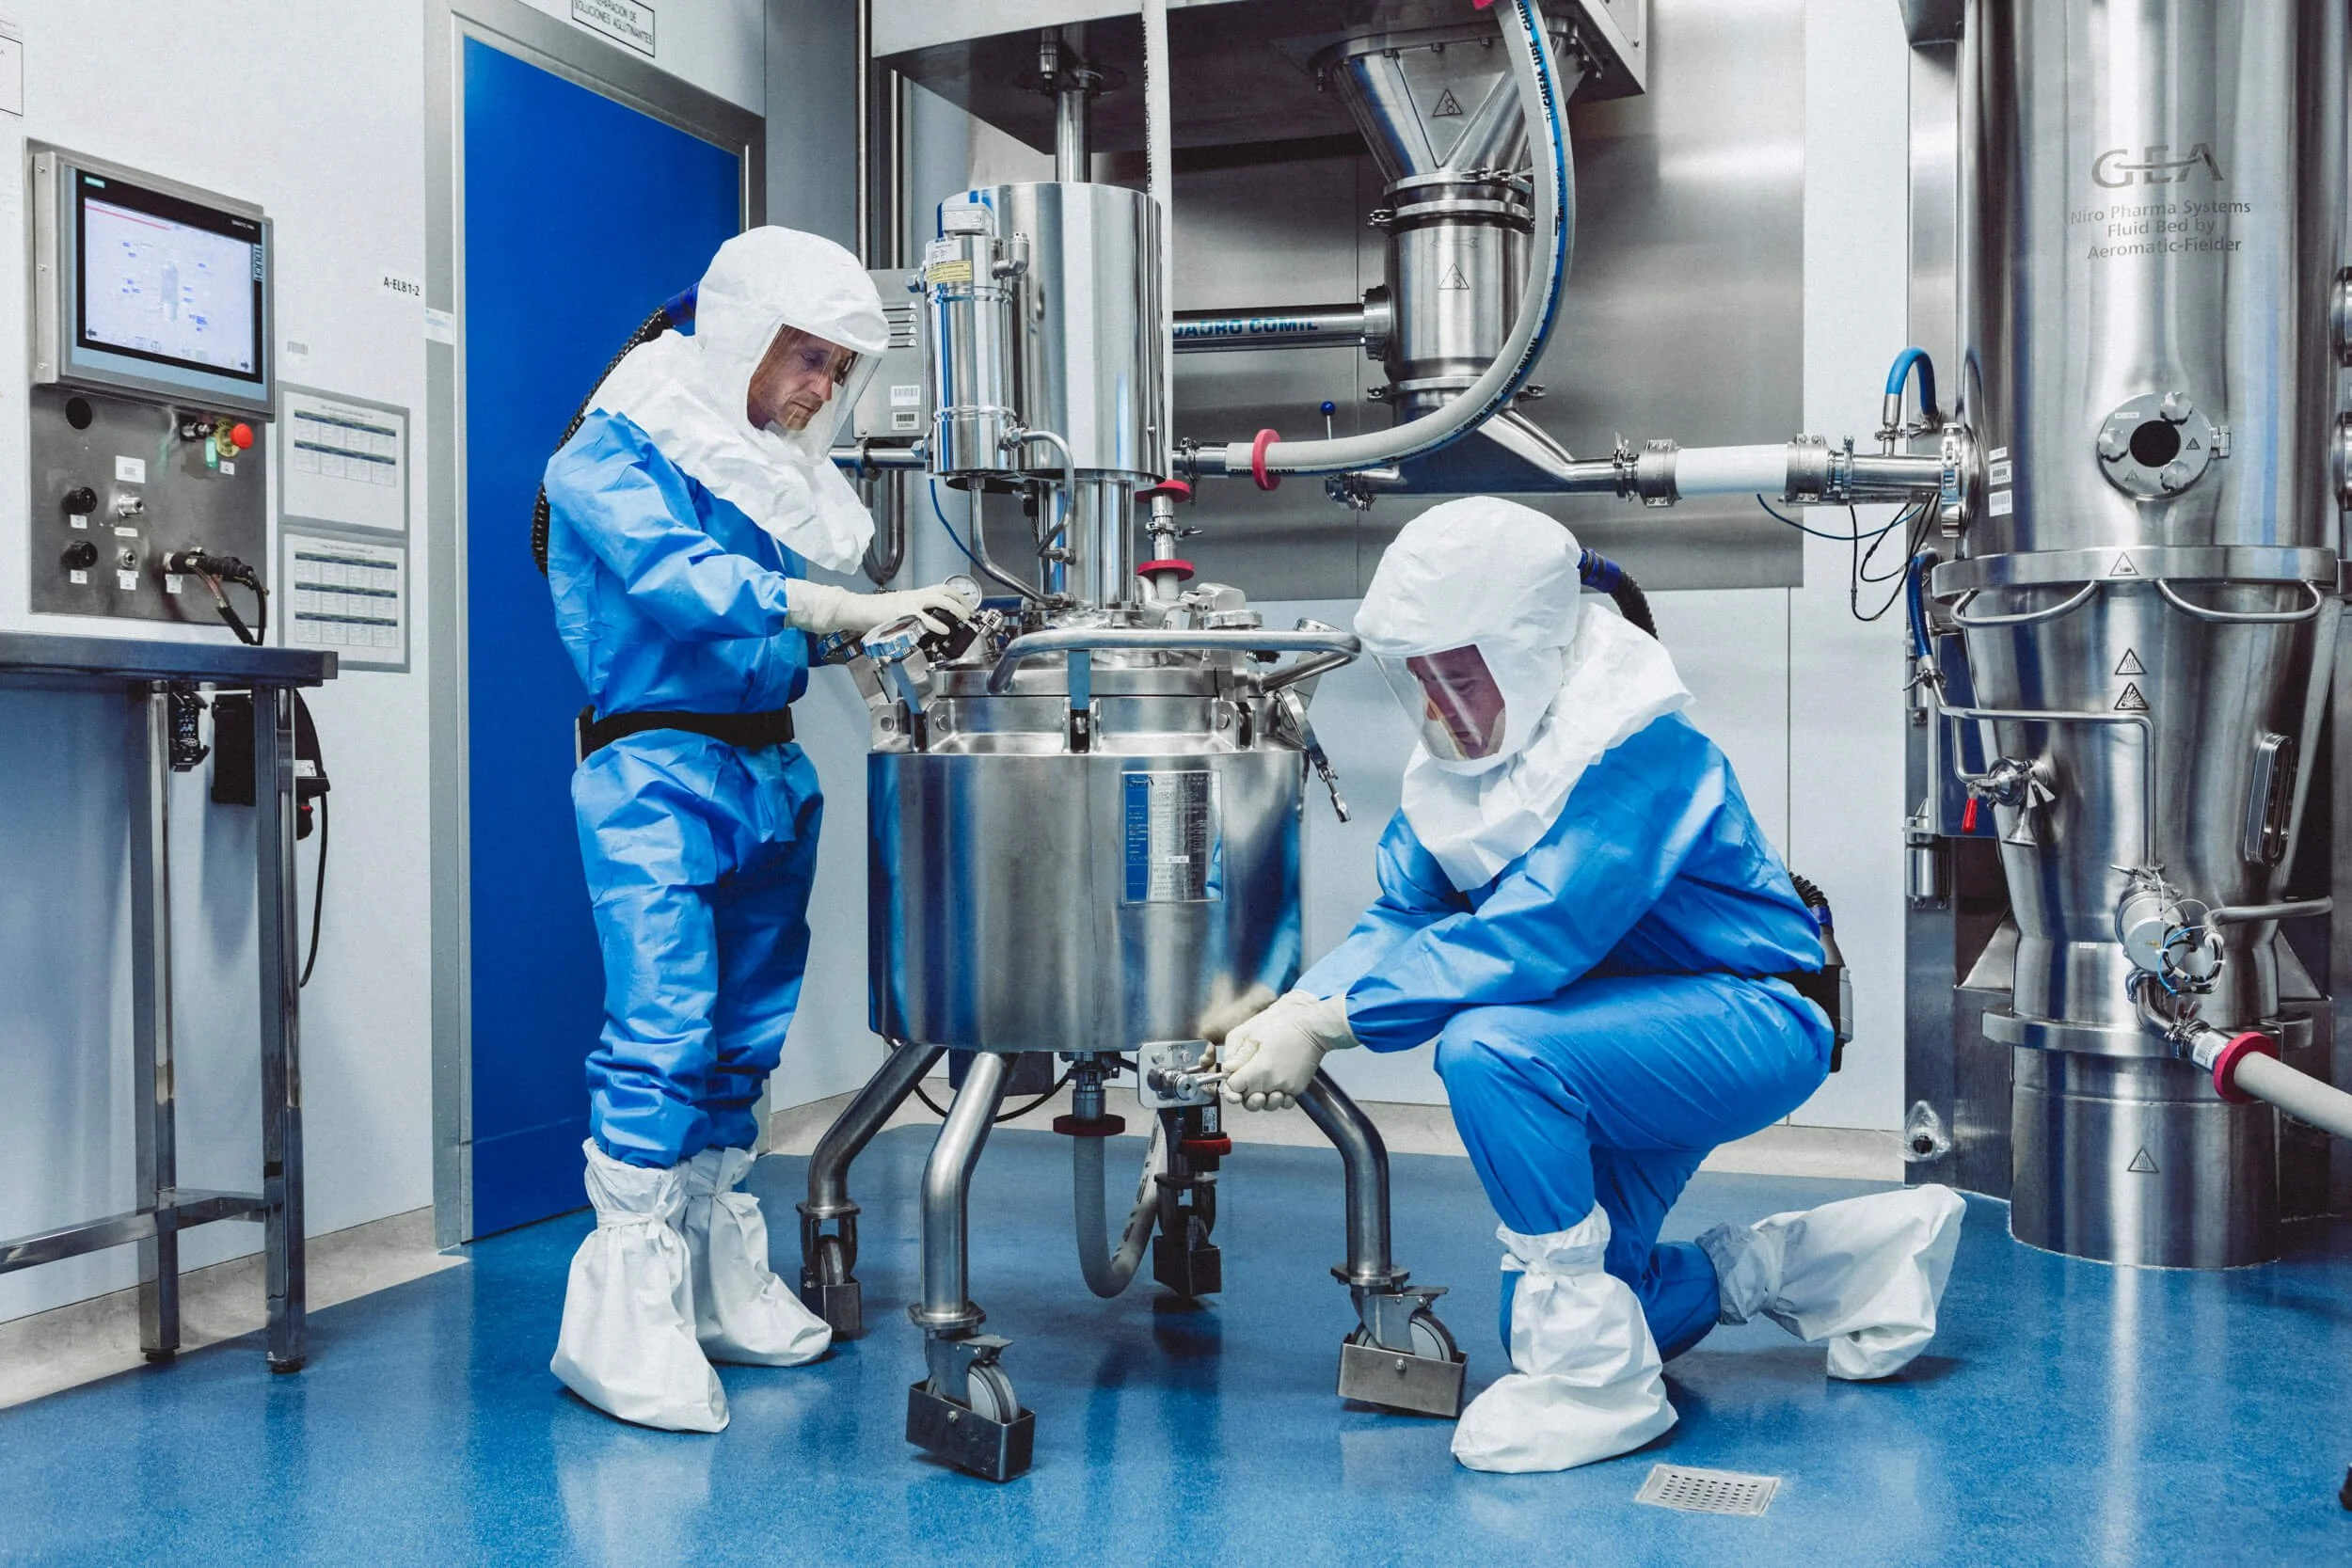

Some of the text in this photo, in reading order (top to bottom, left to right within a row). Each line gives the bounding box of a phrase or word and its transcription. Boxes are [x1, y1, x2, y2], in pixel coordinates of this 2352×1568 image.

[1516, 0, 1534, 31] CHIP
[1529, 39, 1544, 66] UPE
[2091, 143, 2224, 189] GEA
[2070, 199, 2251, 225] Niro Pharma Systems
[2107, 217, 2217, 238] Fluid Bed by
[2087, 237, 2242, 260] Aeromatic-Fielder
[253, 245, 264, 282] TOUCH
[1173, 320, 1244, 337] UADRO
